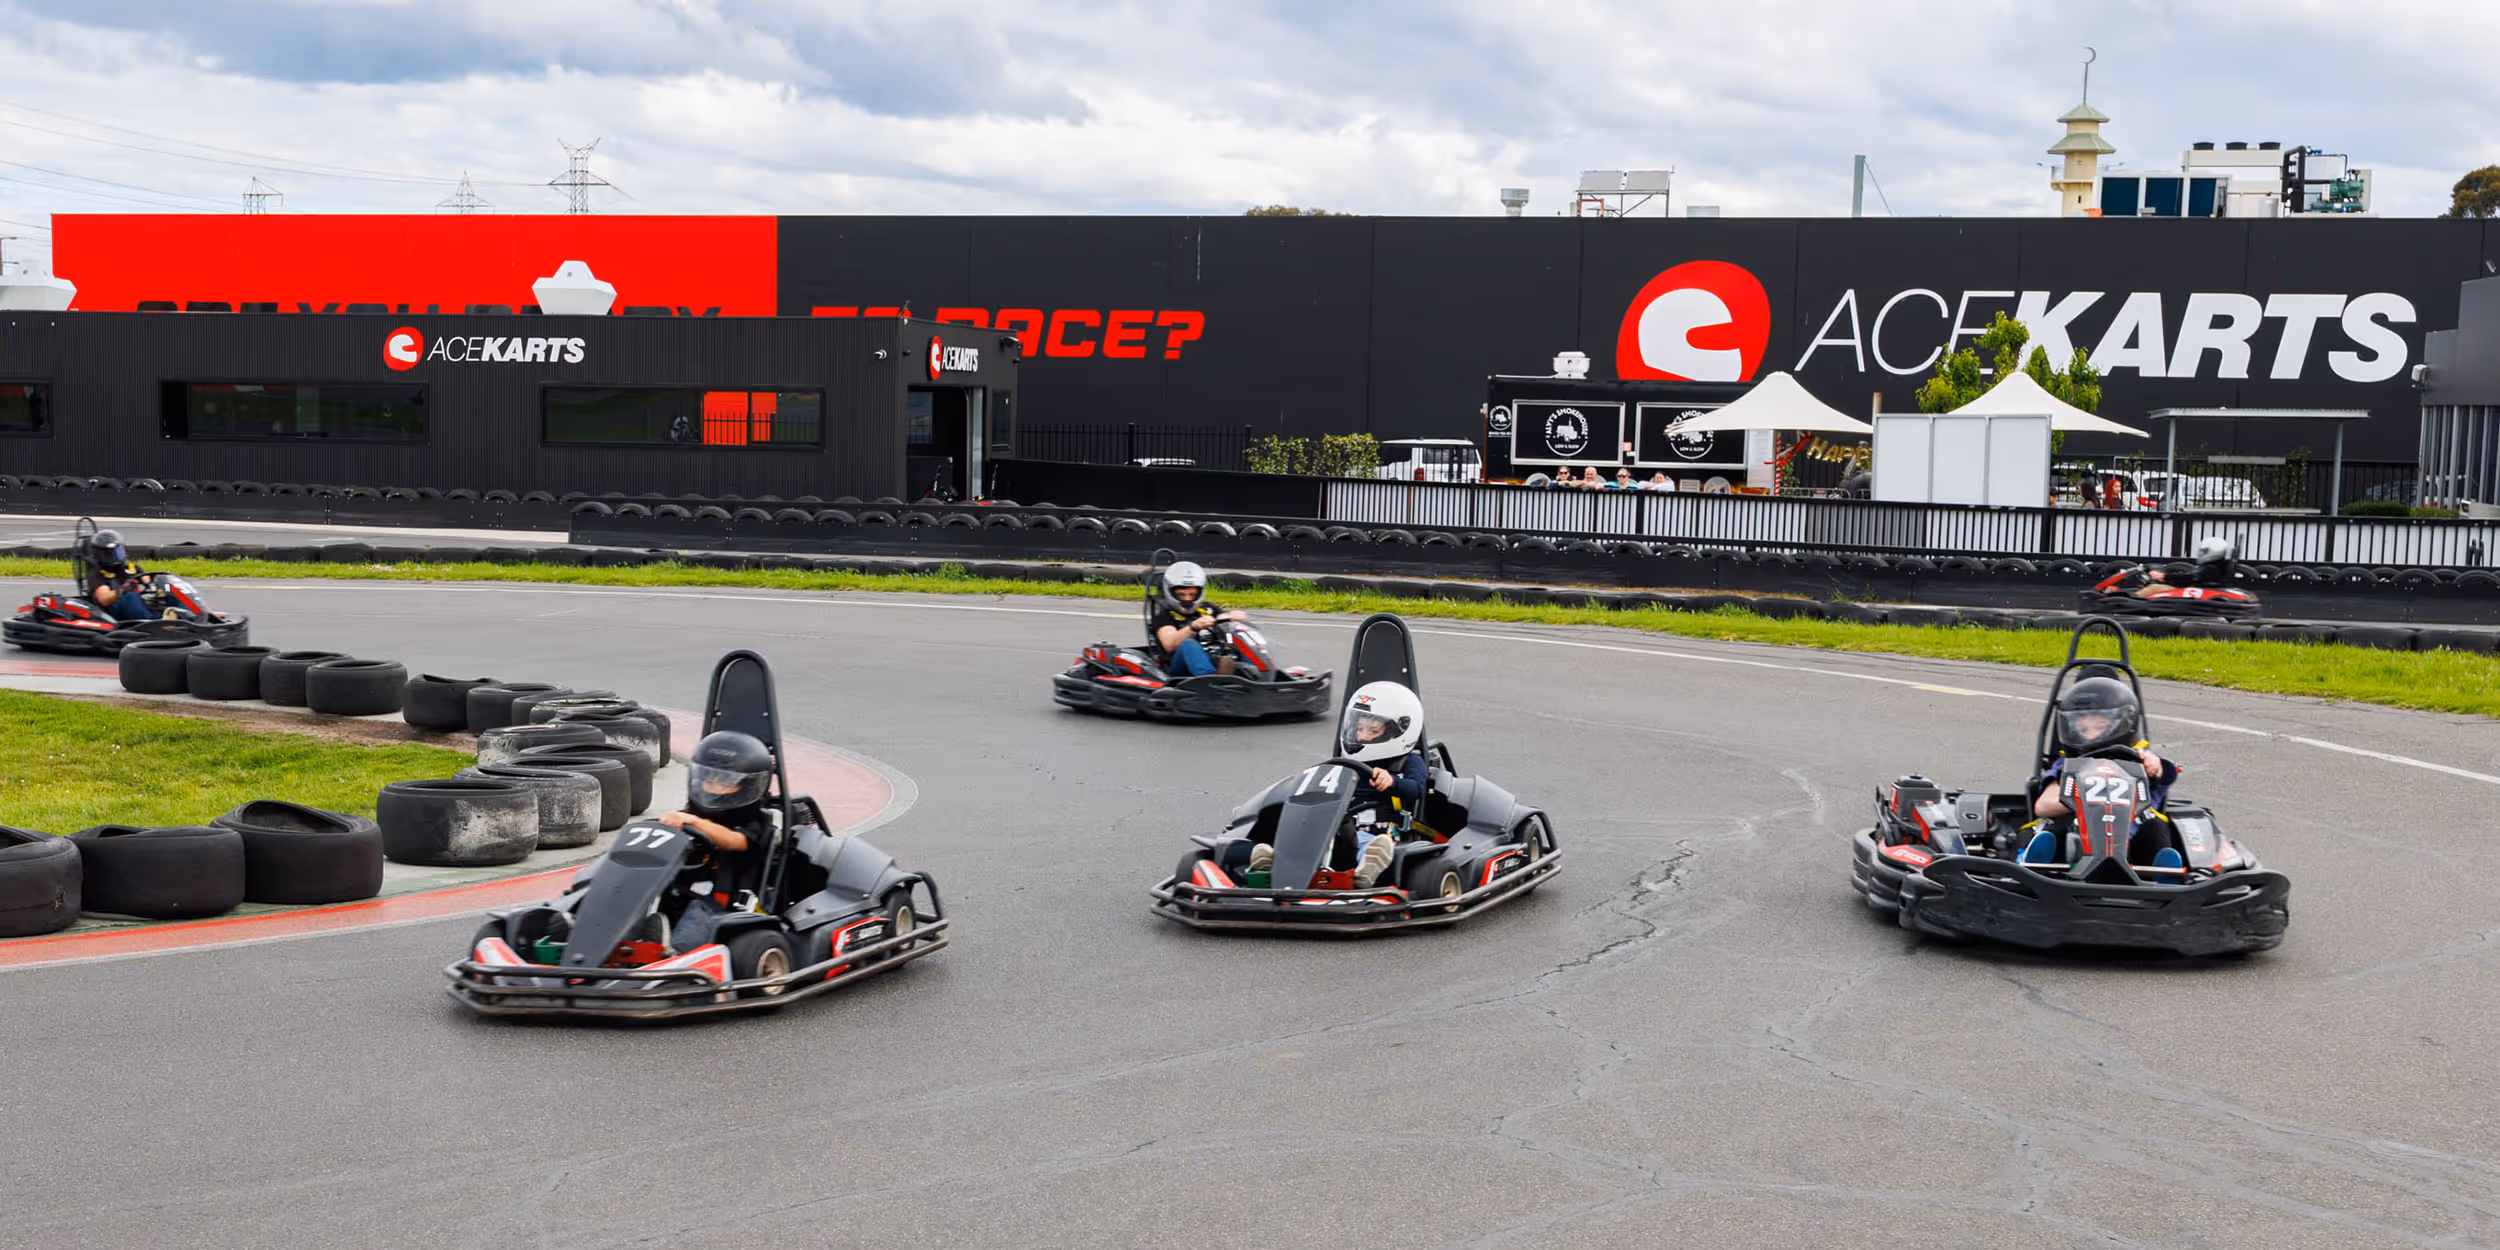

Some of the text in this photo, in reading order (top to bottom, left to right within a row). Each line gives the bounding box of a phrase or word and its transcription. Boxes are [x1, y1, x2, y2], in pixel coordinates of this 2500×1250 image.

[427, 336, 586, 364] ACEKARTS
[1794, 288, 2416, 383] ACEKARTS
[941, 346, 979, 372] ACEKARTS
[1556, 408, 1588, 435] SMOKEHOUSE
[1806, 436, 1872, 467] HAPP
[1294, 765, 1344, 796] 14
[2084, 776, 2131, 806] 22
[625, 827, 677, 849] 77
